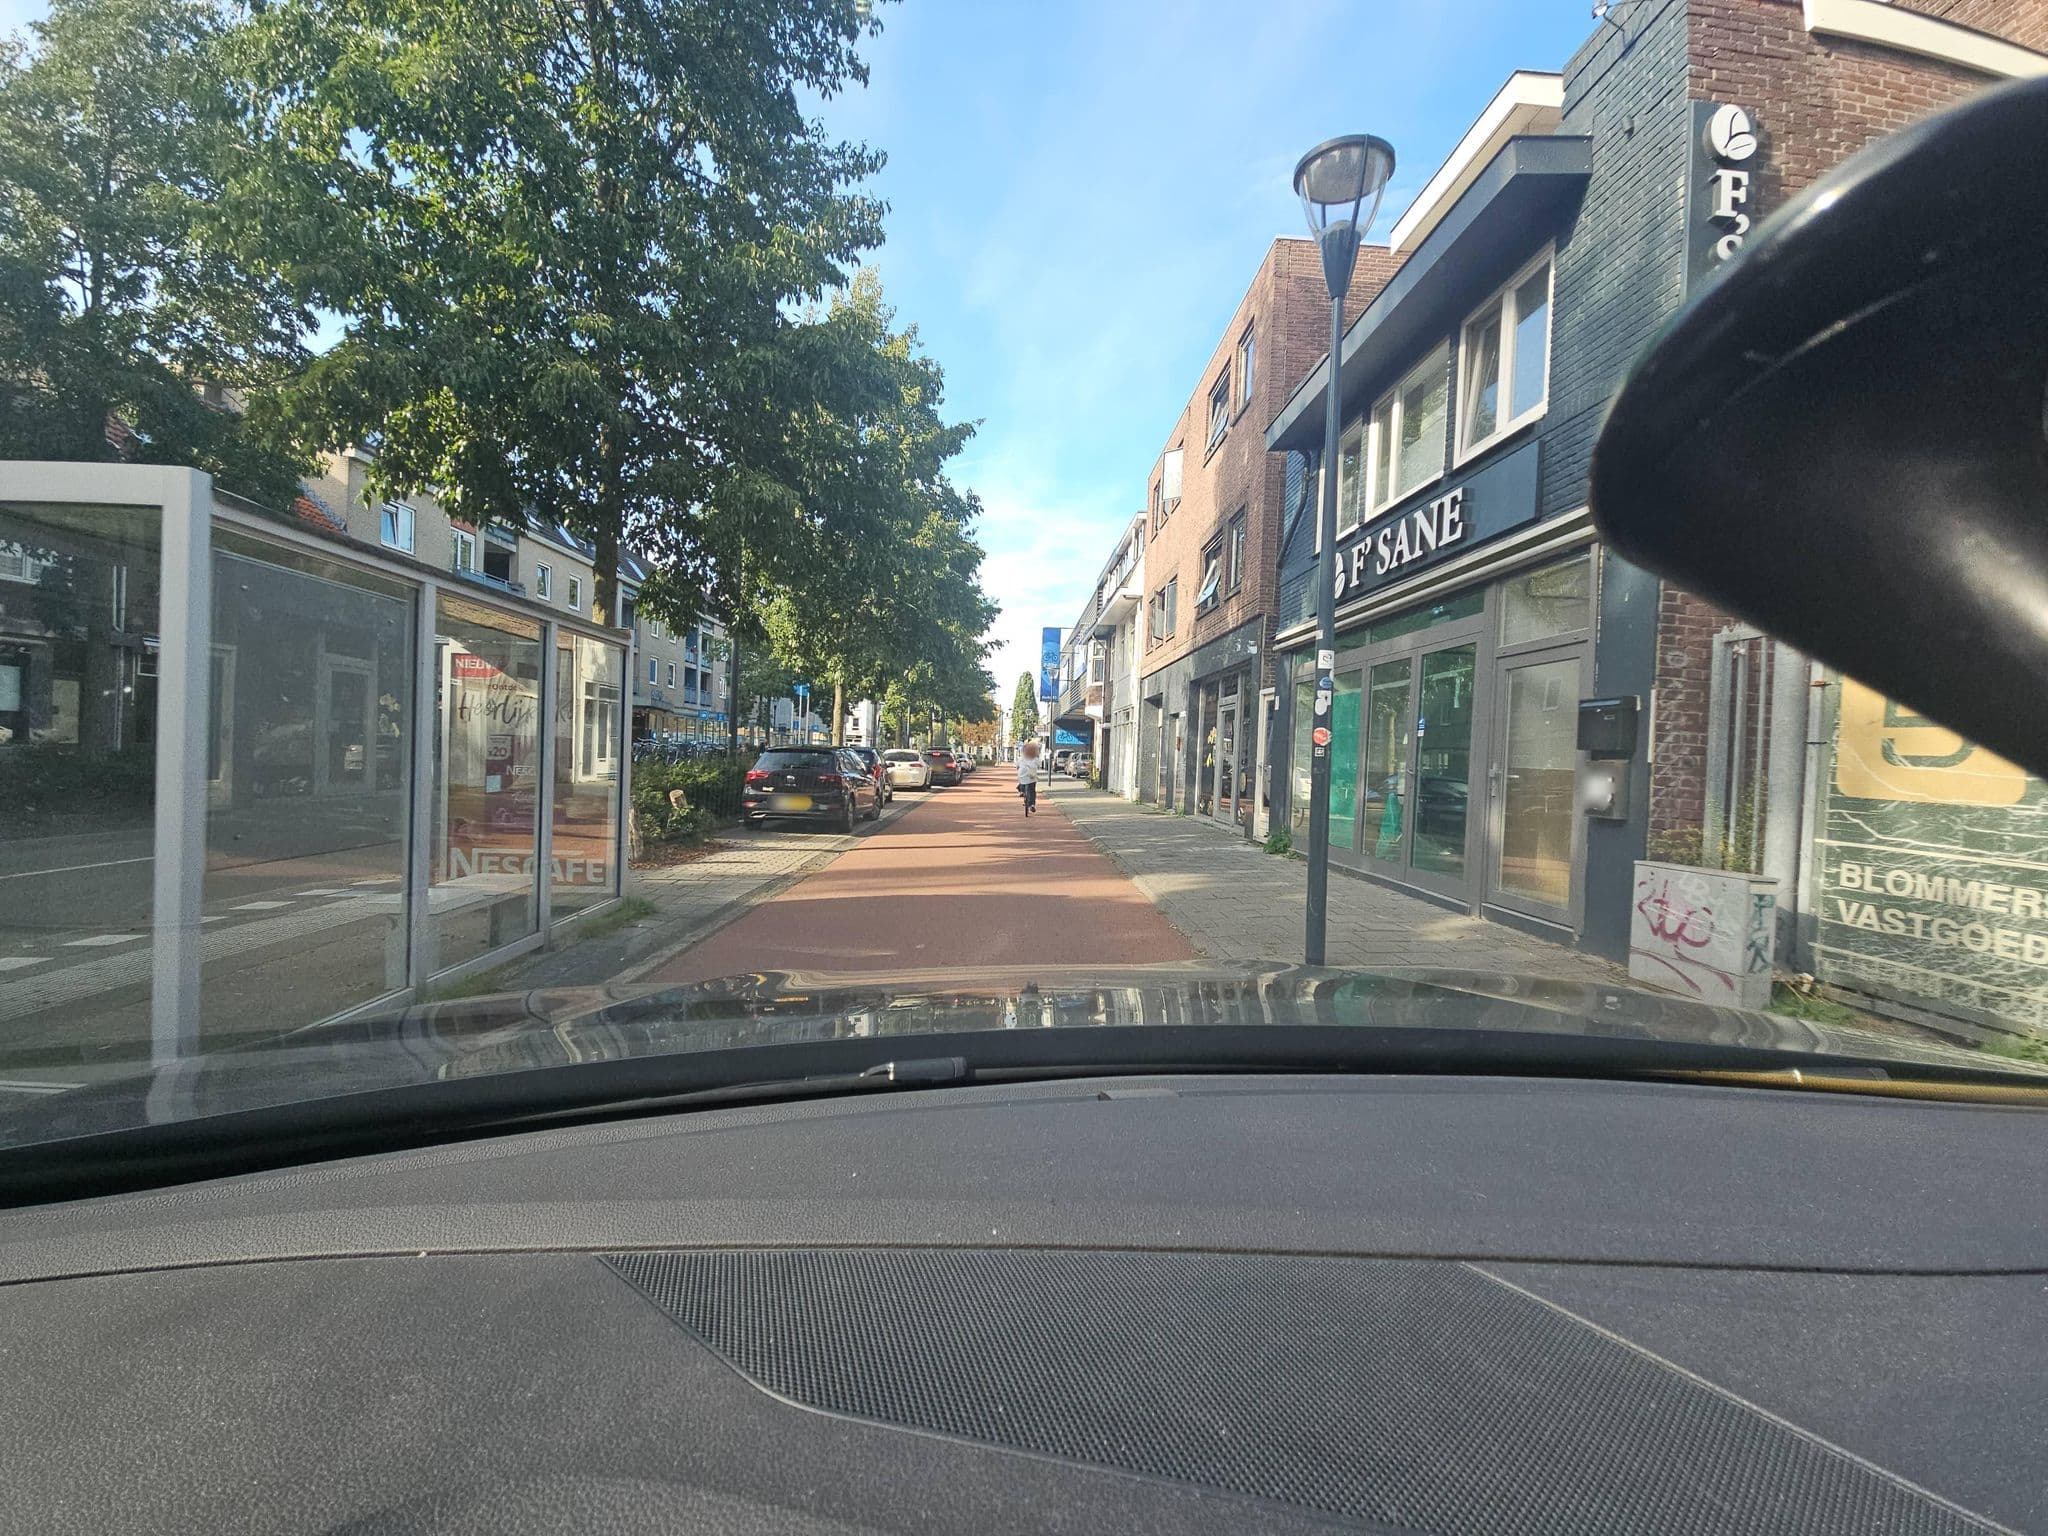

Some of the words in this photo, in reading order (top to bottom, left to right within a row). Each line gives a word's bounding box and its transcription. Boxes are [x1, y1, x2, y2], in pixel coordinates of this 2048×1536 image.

[1375, 487, 1465, 575] SANE
[1839, 863, 2048, 918] BLOMMER
[1837, 899, 2048, 965] VASTGOED
